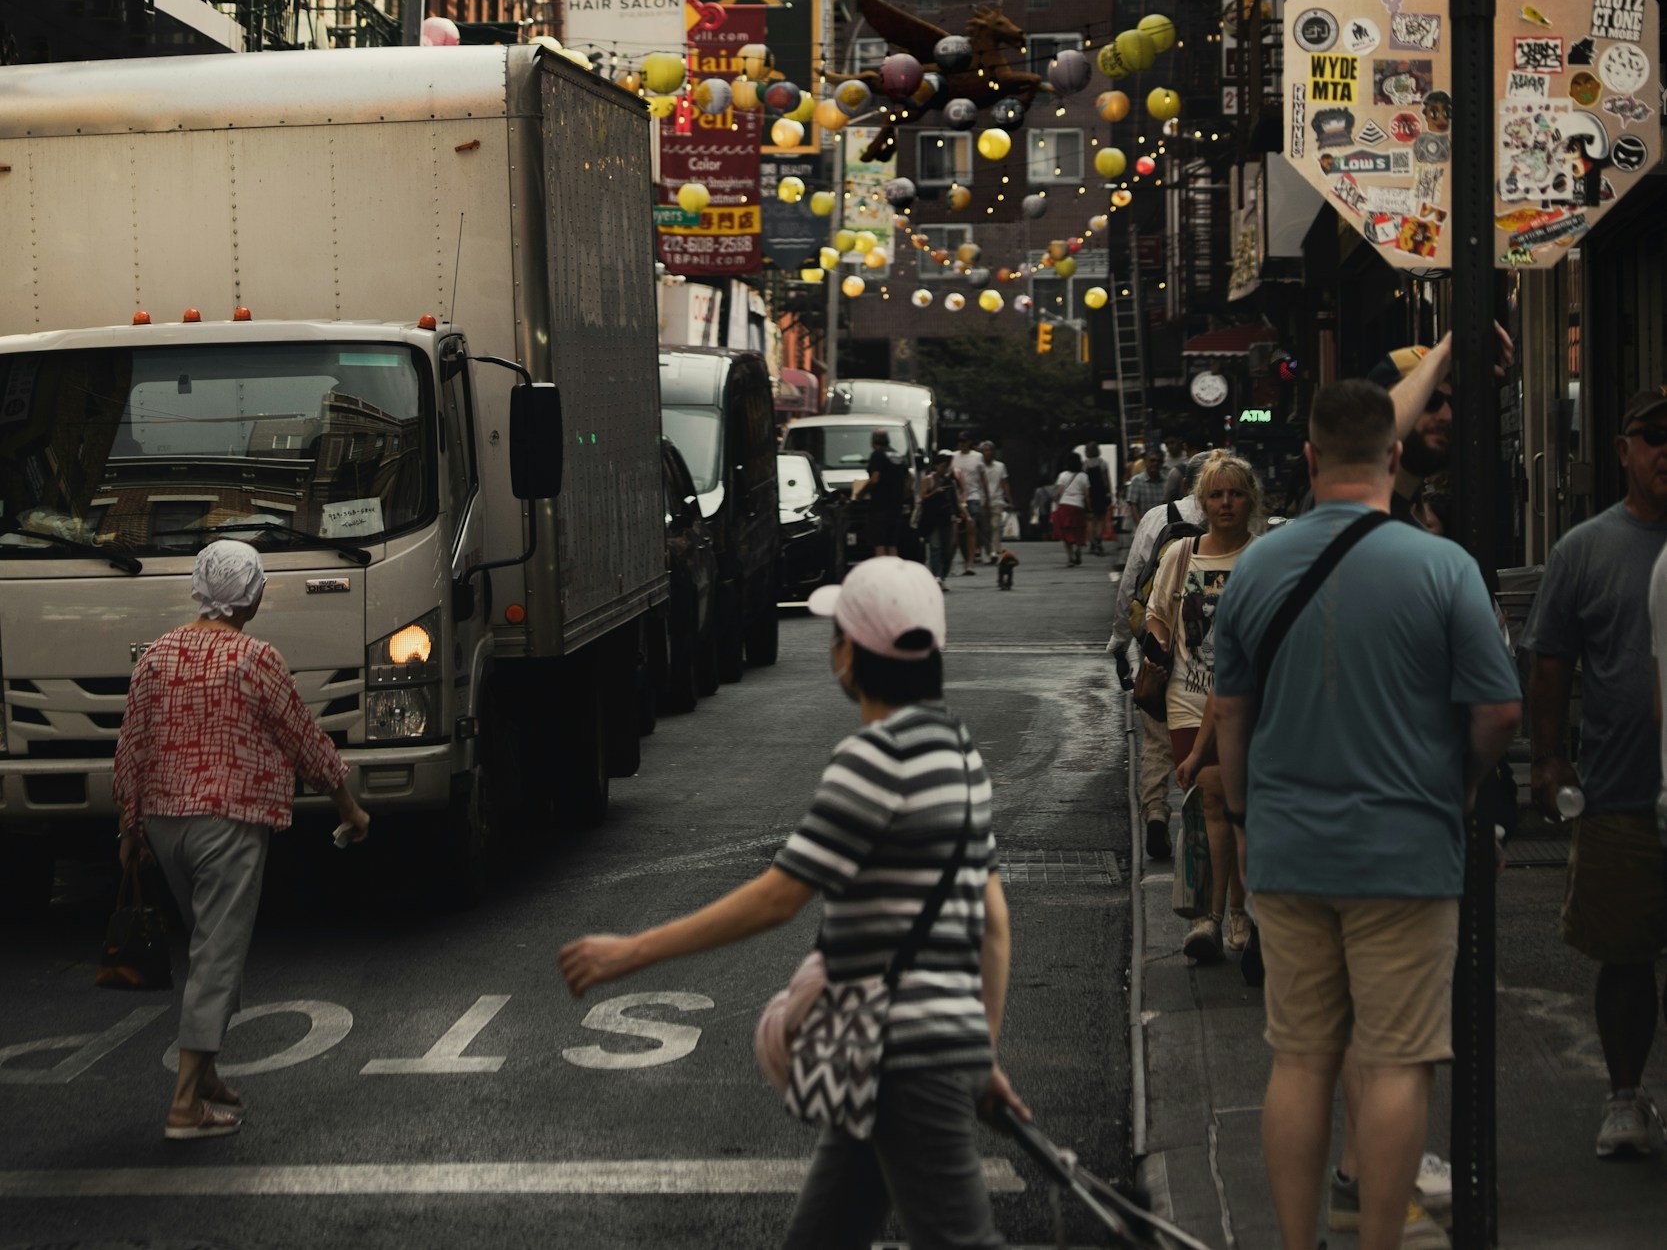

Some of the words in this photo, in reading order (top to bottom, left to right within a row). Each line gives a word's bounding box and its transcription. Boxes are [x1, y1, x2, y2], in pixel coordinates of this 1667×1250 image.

[570, 0, 612, 10] HAIR
[1613, 10, 1643, 31] ONE
[694, 31, 749, 42] ell.com
[1311, 55, 1358, 80] WYDE
[1312, 80, 1352, 101] MTA
[688, 157, 722, 172] Color
[1240, 409, 1272, 423] ATM
[0, 991, 715, 1084] STOP
